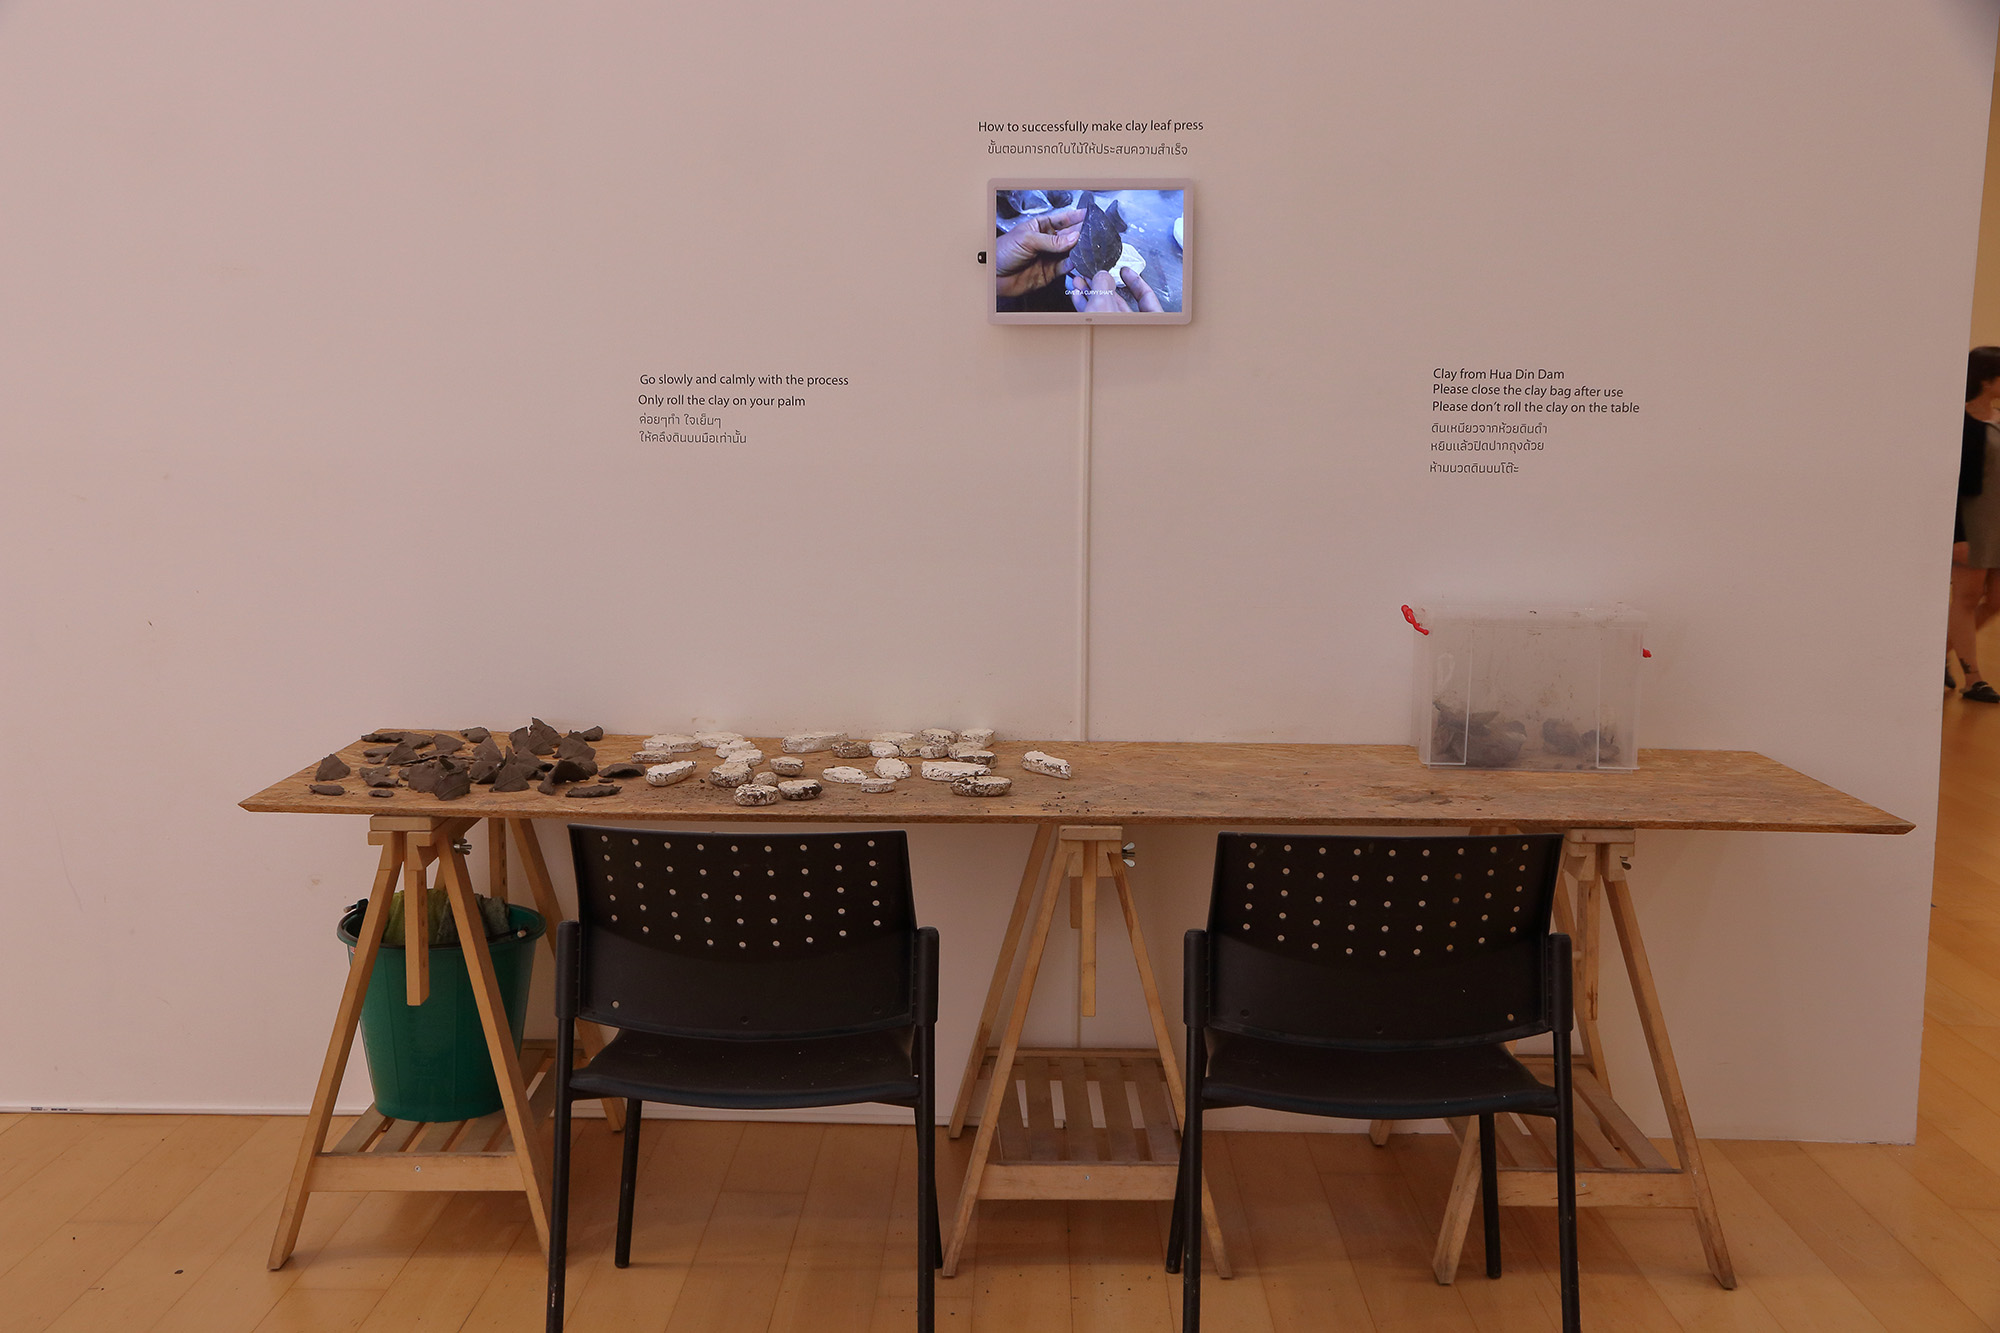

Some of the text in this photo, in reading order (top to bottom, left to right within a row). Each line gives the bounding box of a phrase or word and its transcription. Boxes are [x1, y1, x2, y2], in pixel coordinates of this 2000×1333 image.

[979, 120, 1203, 134] How to successfully make clay leaf press
[640, 374, 848, 387] Go slowly and calmly with the process
[1434, 368, 1564, 381] Clay from Hua Din Dam
[1433, 384, 1623, 399] Please close the clay bag after use
[638, 395, 664, 407] Only
[667, 395, 684, 405] roll
[687, 395, 705, 405] the
[708, 395, 729, 408] clay
[750, 398, 774, 408] your
[778, 396, 805, 408] palm
[1433, 401, 1468, 411] Please
[1504, 402, 1521, 412] roll
[1525, 402, 1543, 412] the
[1546, 402, 1568, 415] clay
[1589, 402, 1607, 412] the
[1611, 402, 1639, 413] table
